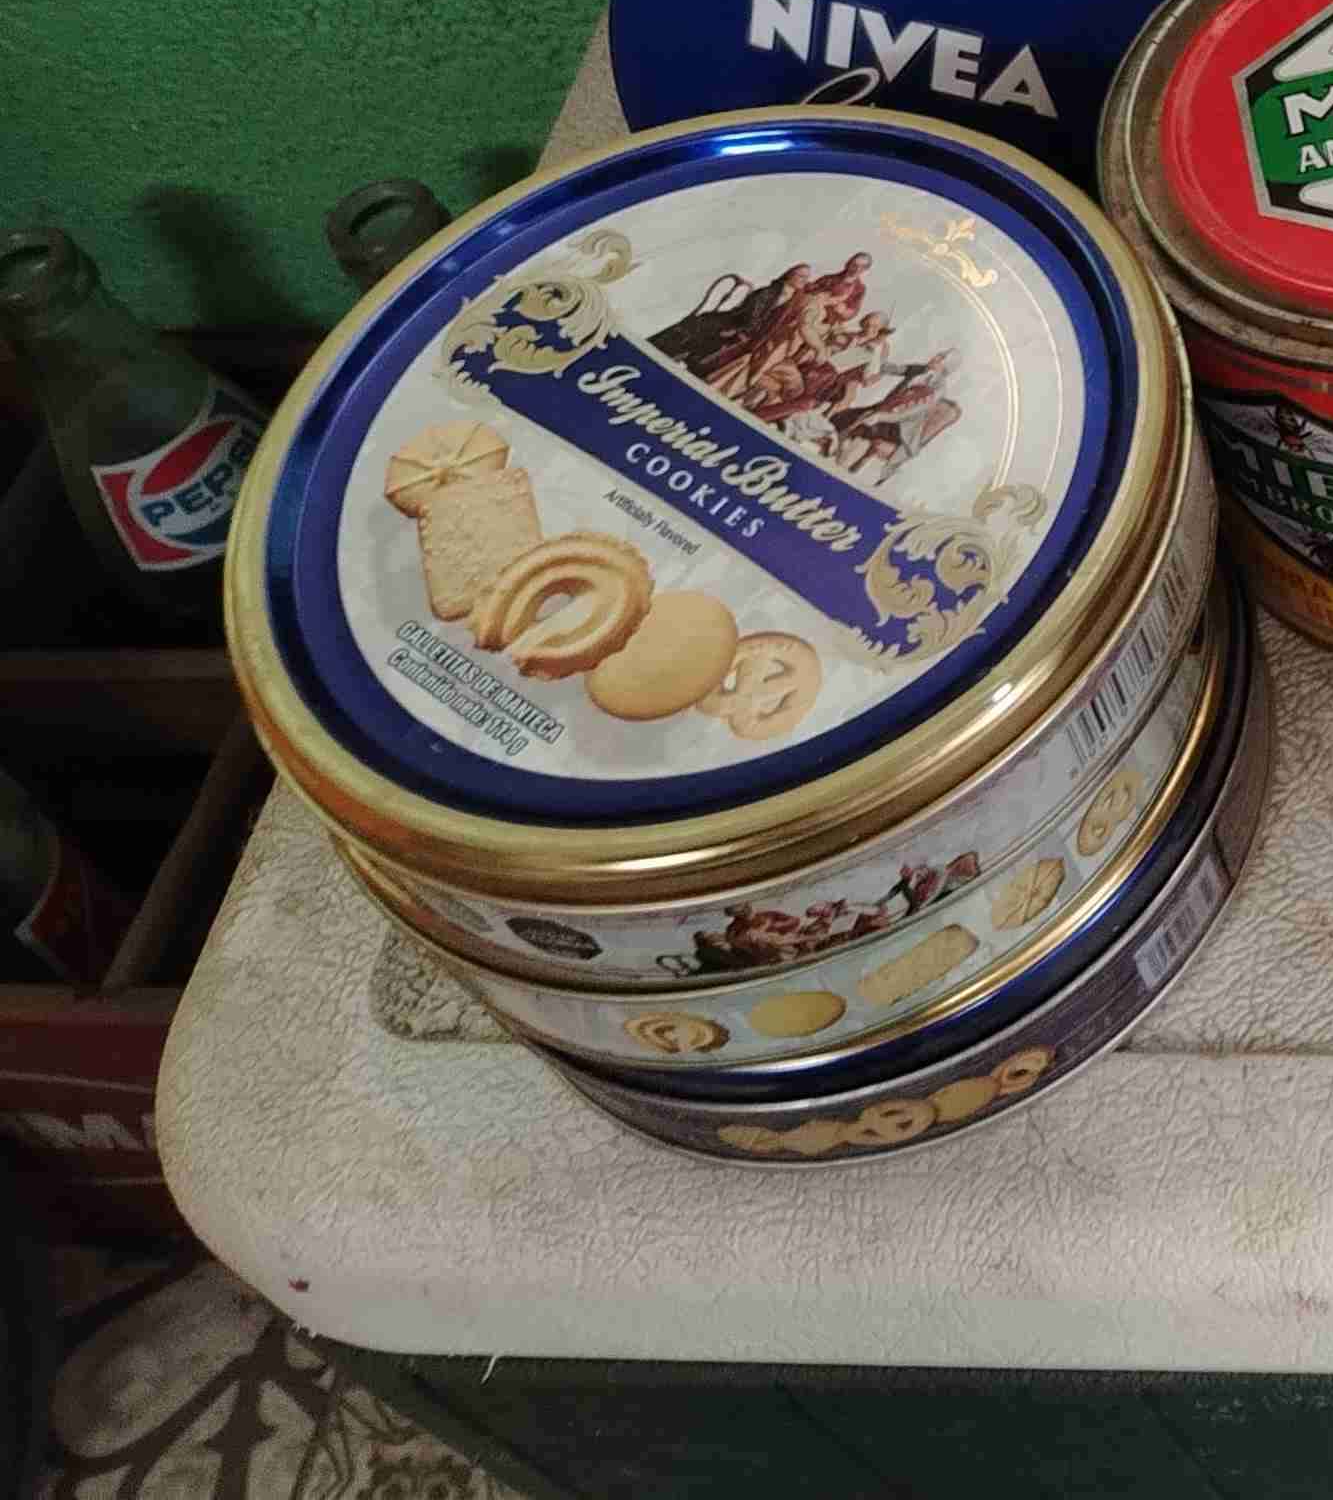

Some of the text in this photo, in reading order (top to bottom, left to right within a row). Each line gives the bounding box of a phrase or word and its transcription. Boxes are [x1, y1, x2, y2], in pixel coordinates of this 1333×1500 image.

[577, 363, 863, 553] Imperial Butter
[625, 441, 766, 540] COOKIES
[603, 488, 702, 557] Artificially Flavored
[387, 648, 457, 705] Contenido
[396, 619, 566, 745] GALLETITAS DE MANTECA
